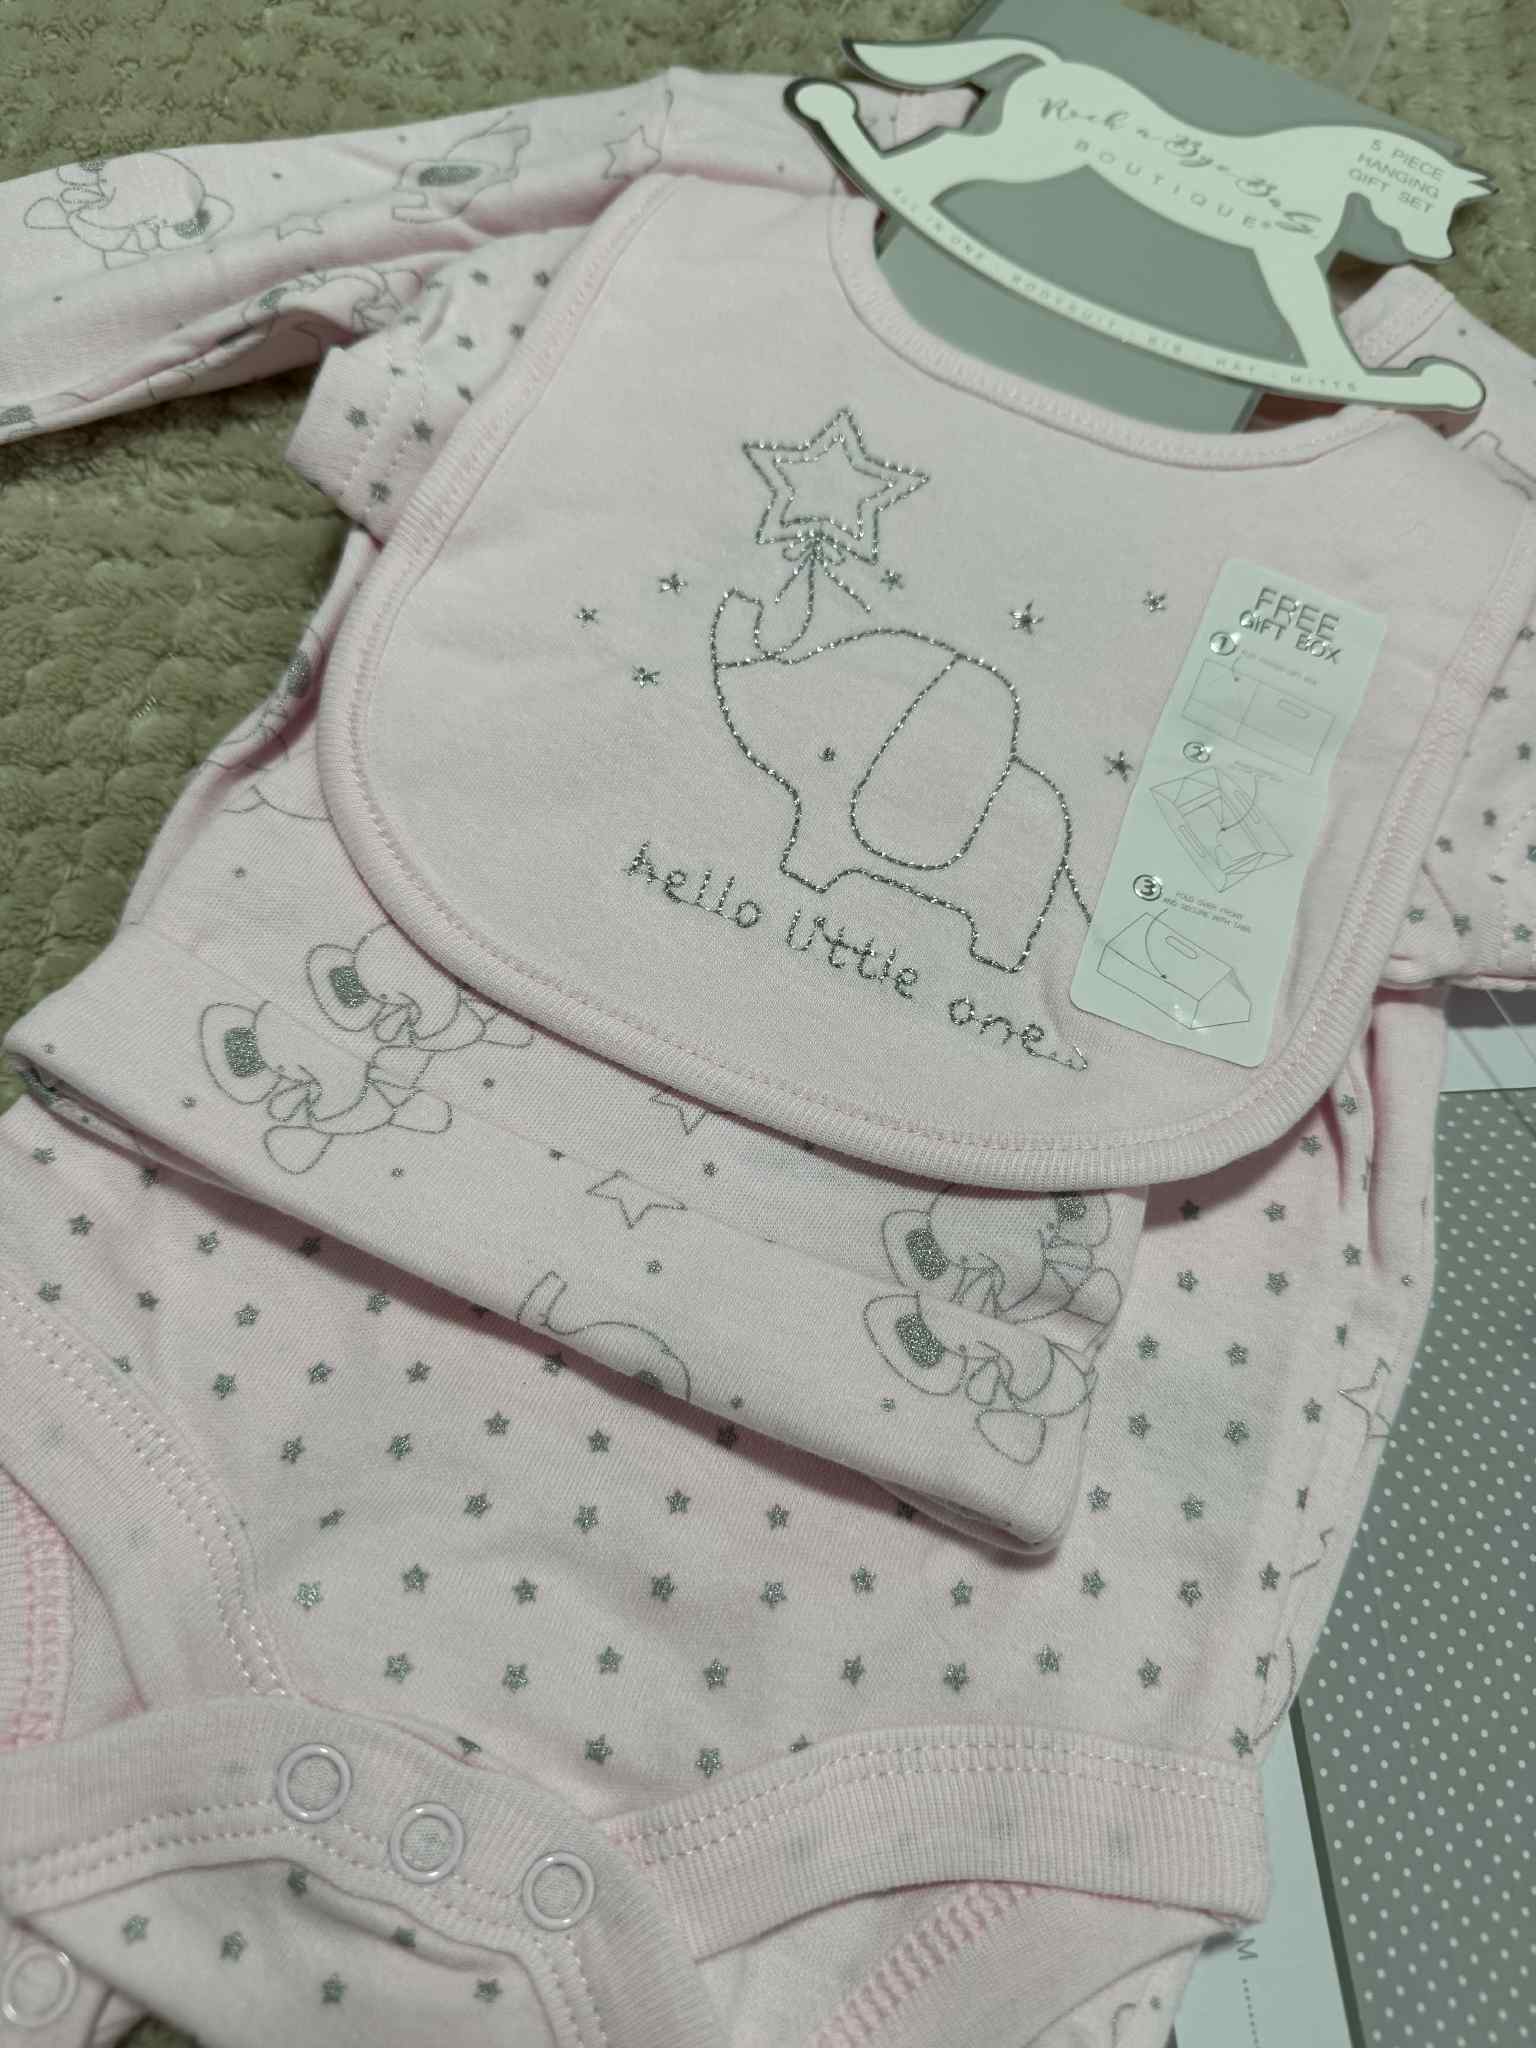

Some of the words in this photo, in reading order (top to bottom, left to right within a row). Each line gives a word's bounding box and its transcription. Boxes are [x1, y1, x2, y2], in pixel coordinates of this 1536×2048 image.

[1357, 153, 1439, 198] HANGING
[1370, 139, 1382, 151] 5
[1391, 149, 1444, 181] PIECE
[1348, 168, 1390, 193] GIFT
[1399, 192, 1433, 213] SET
[1239, 609, 1287, 641] GIFT
[1296, 634, 1342, 665] BOX
[1254, 586, 1341, 642] FREE
[623, 840, 762, 928] hello
[786, 909, 919, 1000] little
[948, 996, 1047, 1058] one
